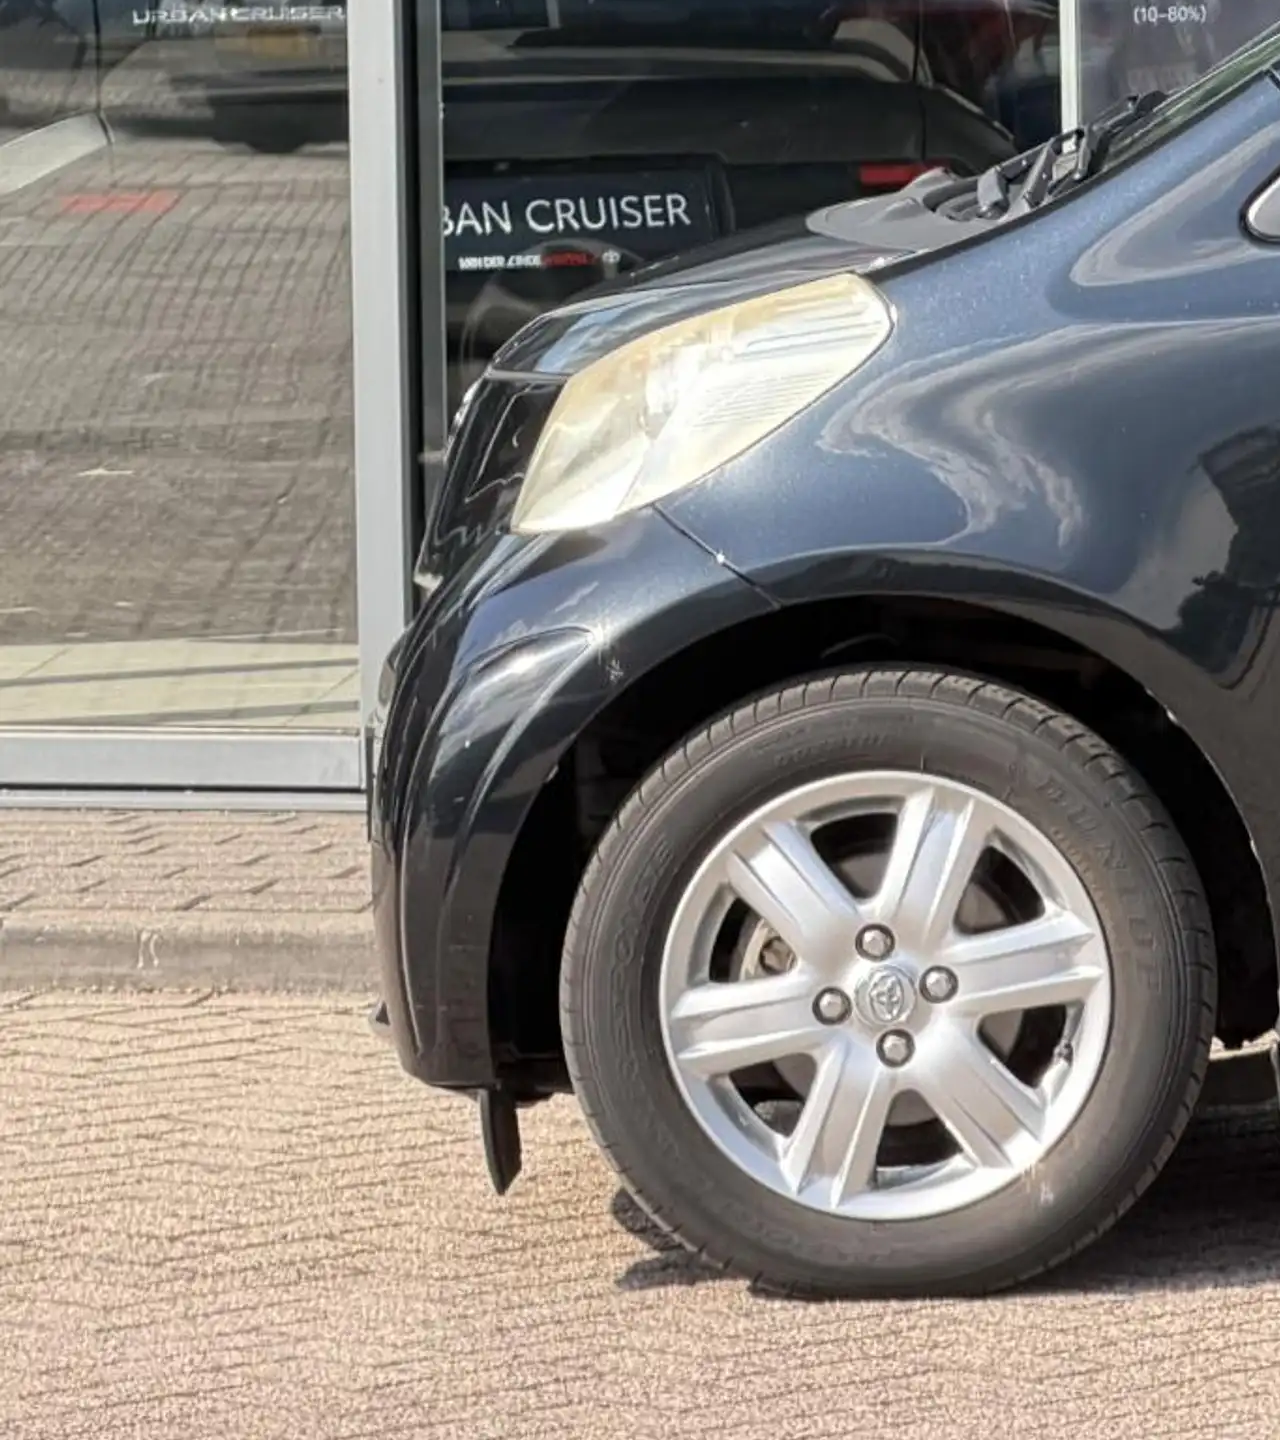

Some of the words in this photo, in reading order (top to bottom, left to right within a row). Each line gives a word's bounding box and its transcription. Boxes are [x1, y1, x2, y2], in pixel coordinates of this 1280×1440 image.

[132, 7, 226, 25] URBAN
[231, 5, 345, 22] CRUISER
[526, 194, 691, 233] CRUISER
